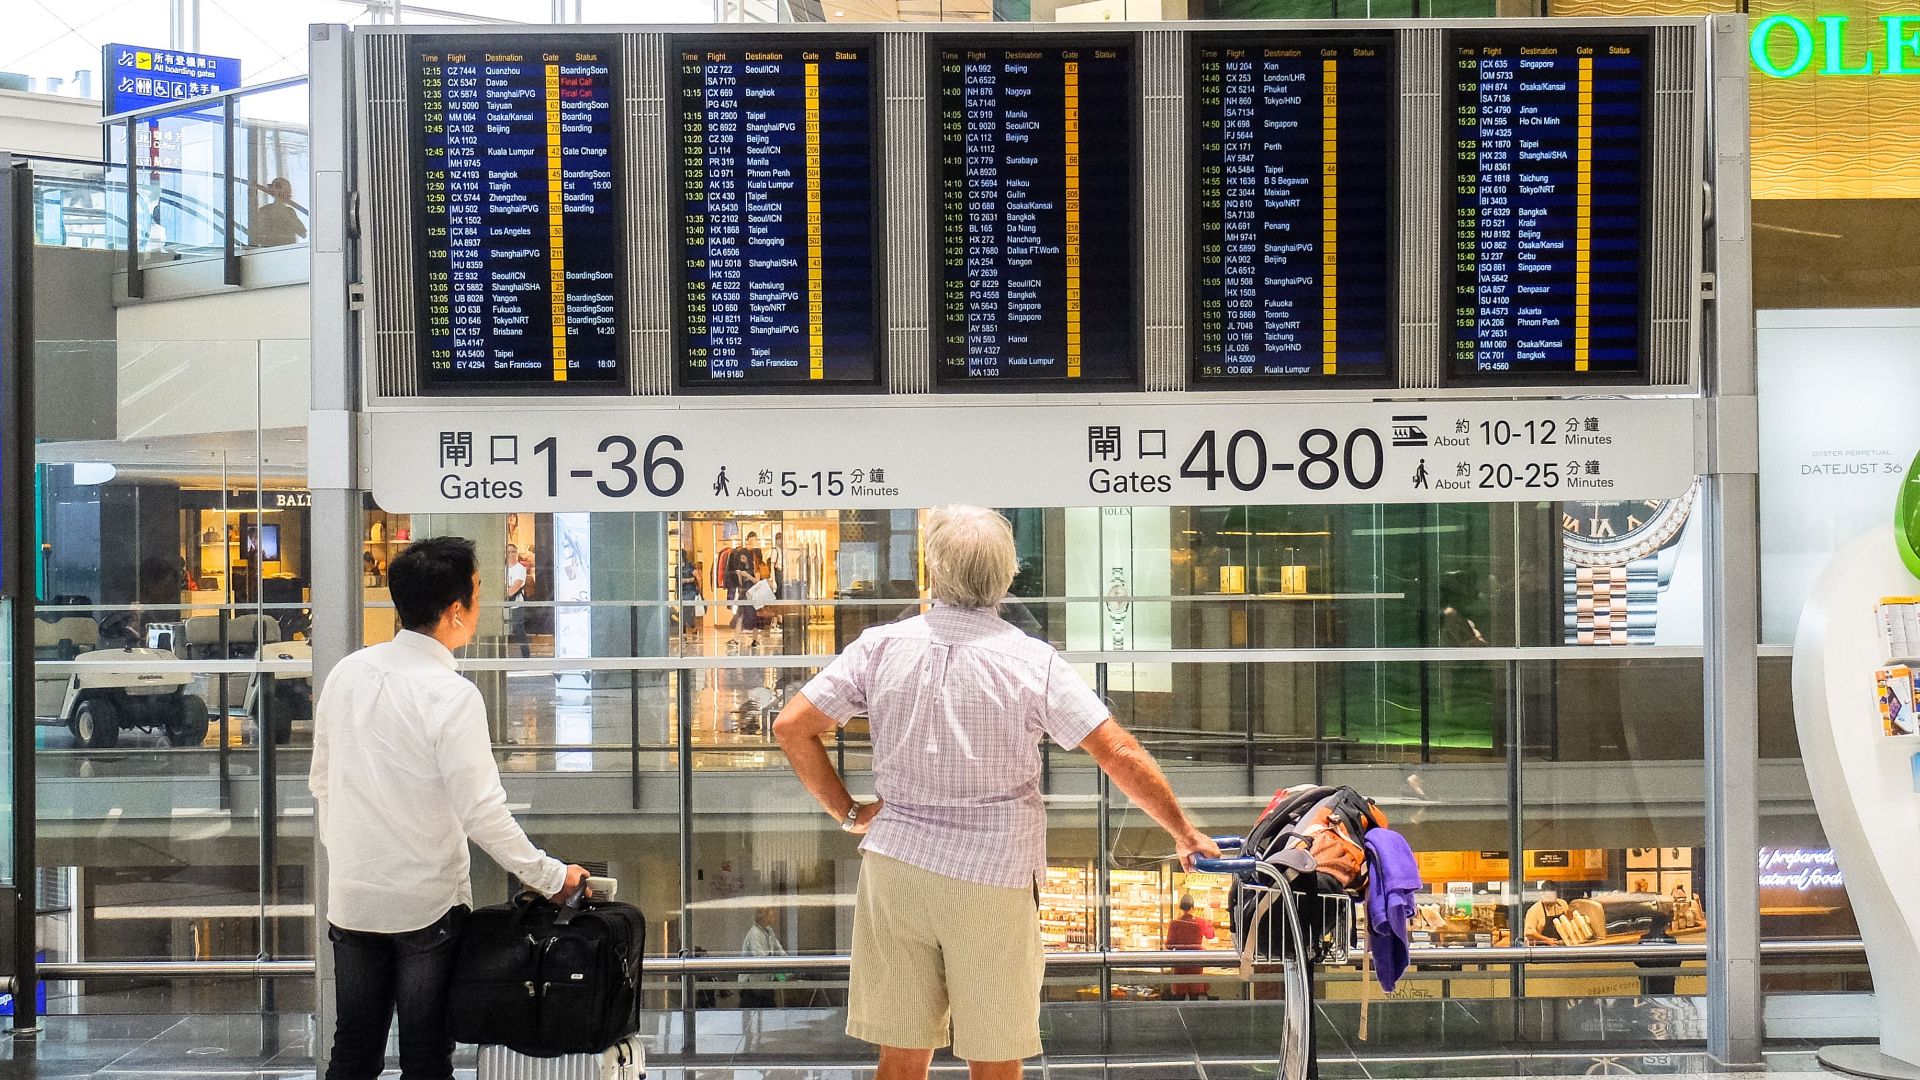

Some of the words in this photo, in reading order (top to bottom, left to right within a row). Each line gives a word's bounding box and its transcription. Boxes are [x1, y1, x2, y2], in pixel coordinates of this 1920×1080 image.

[1483, 47, 1501, 55] Flight
[1750, 14, 1920, 78] OLE
[448, 54, 466, 63] Flight
[576, 53, 597, 61] Status
[708, 53, 726, 62] Flight
[968, 52, 986, 61] Flight
[1227, 50, 1244, 59] Flight
[165, 66, 196, 78] boarding
[448, 67, 458, 75] CZ
[560, 66, 608, 76] BoardingSoon
[746, 65, 779, 73] Seoul/ICN
[1005, 64, 1027, 74] Beijing
[448, 78, 460, 86] CX
[1264, 74, 1305, 82] London/LHR
[487, 113, 533, 121] Osaka/Kansai
[562, 112, 592, 122] Boarding
[509, 148, 534, 157] Lumpur
[563, 147, 579, 155] Gate
[581, 147, 607, 156] Change
[1482, 208, 1492, 216] GF
[1519, 208, 1547, 217] Bangkok
[1018, 224, 1036, 233] Nang
[750, 348, 770, 357] Taipei
[1029, 357, 1054, 366] Lumpur
[1285, 366, 1310, 374] Lumpur
[1456, 419, 1470, 434] 約
[1480, 420, 1556, 445] 10-12
[1566, 417, 1599, 432] 分鐘
[1088, 426, 1166, 462] 閘口
[1434, 436, 1470, 446] About
[1565, 435, 1612, 445] Minutes
[440, 432, 518, 468] 閘口
[1089, 469, 1172, 493] Gates
[1180, 428, 1384, 491] 40-80
[440, 474, 523, 499] Gates
[534, 435, 684, 497] 1-36
[1801, 463, 1878, 475] DATEJUST
[1883, 463, 1903, 474] 36
[1457, 462, 1470, 477] 約
[1479, 463, 1559, 488] 20-25
[1566, 460, 1600, 475] 分鐘
[759, 469, 773, 484] 約
[781, 472, 844, 496] 5-15
[850, 468, 885, 483] 分鐘
[1435, 479, 1471, 489] About
[1567, 478, 1614, 488] Minutes
[737, 487, 773, 497] About
[851, 486, 899, 496] Minutes
